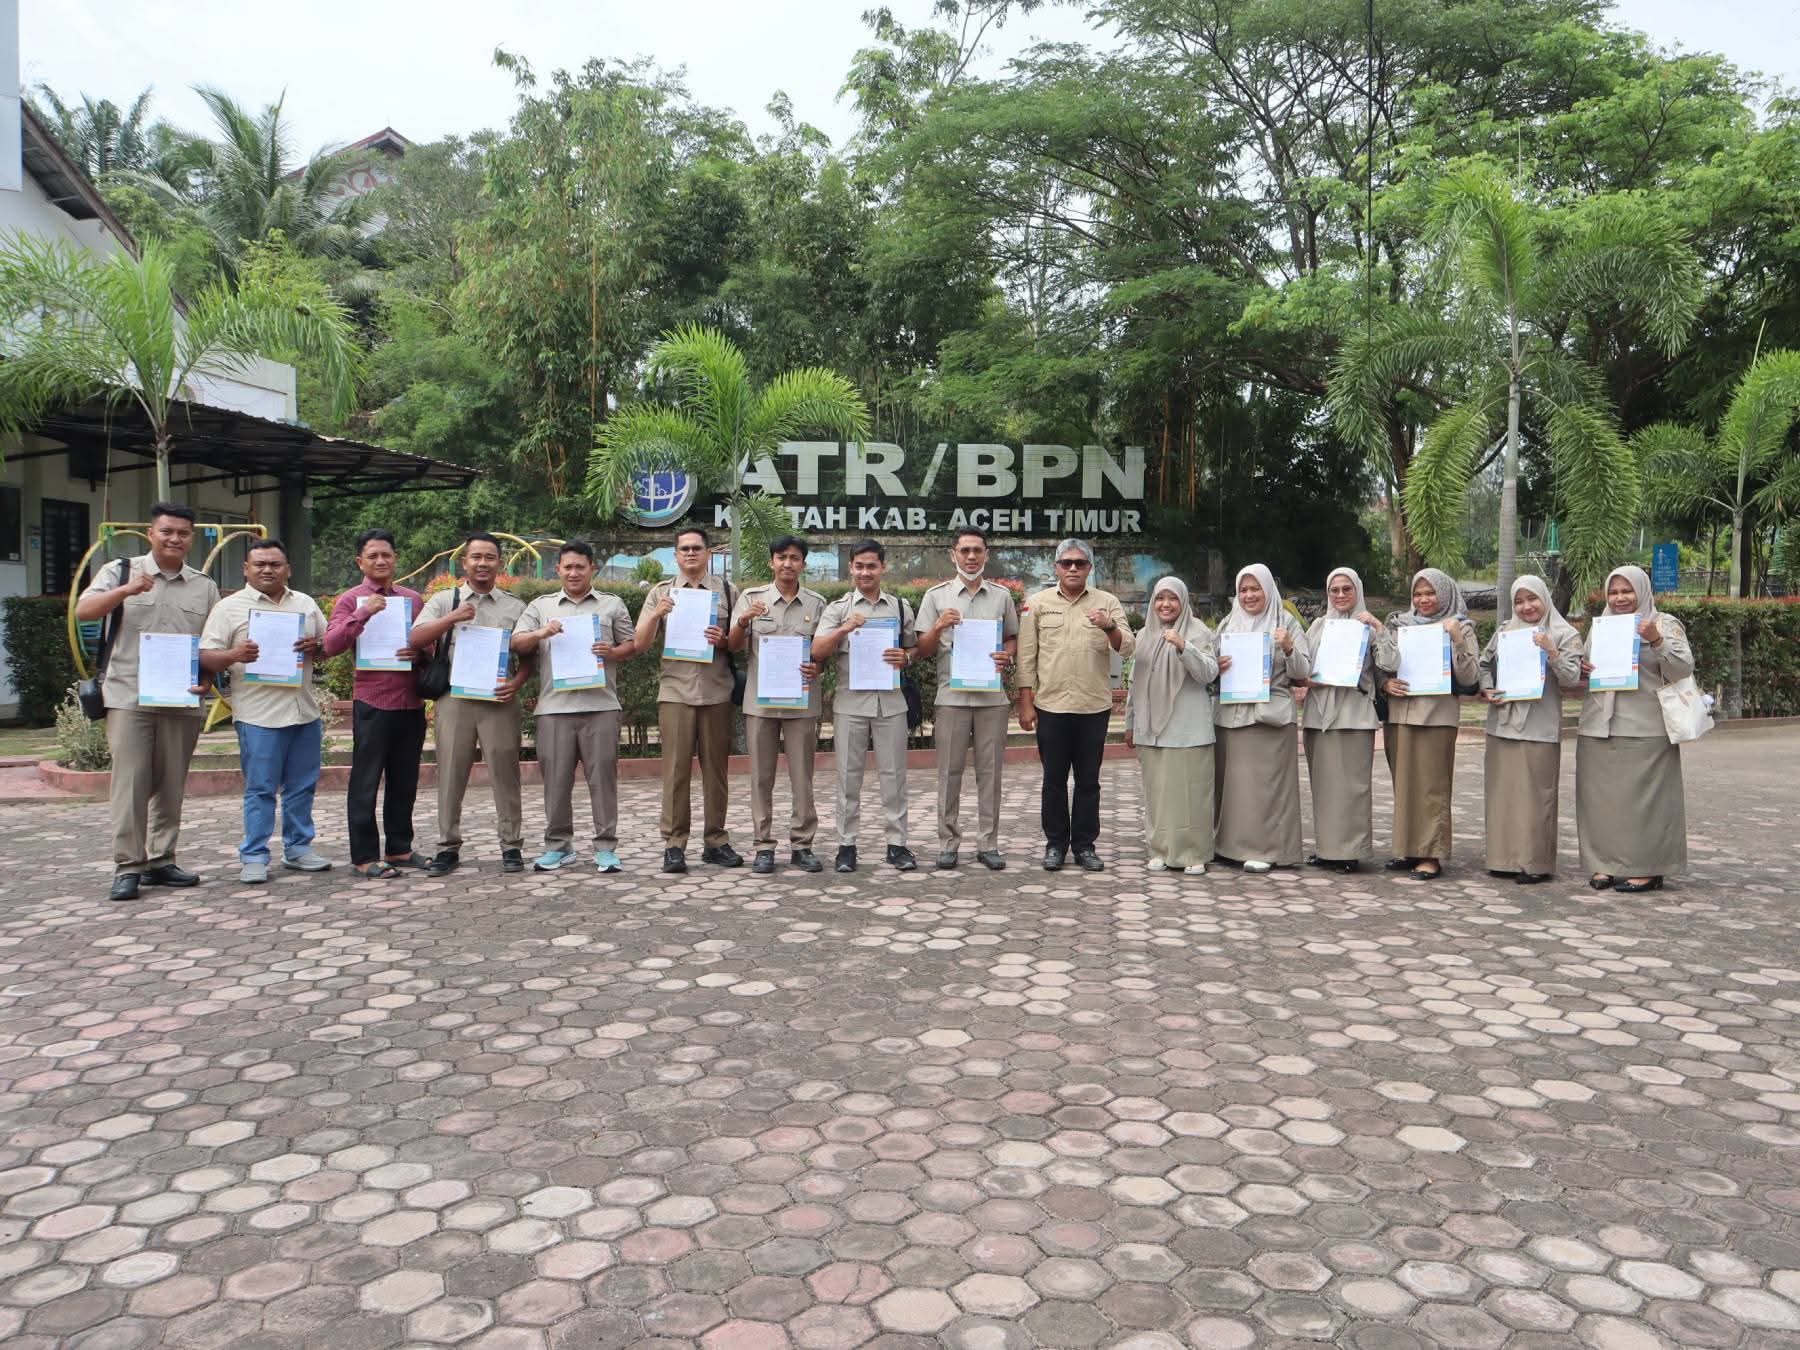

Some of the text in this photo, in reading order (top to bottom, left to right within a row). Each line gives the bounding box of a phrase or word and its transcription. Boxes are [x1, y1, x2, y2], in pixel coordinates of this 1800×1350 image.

[716, 441, 1145, 500] ATR/BPN
[714, 504, 1142, 533] KTAH KAB. ACEH TIMUR
